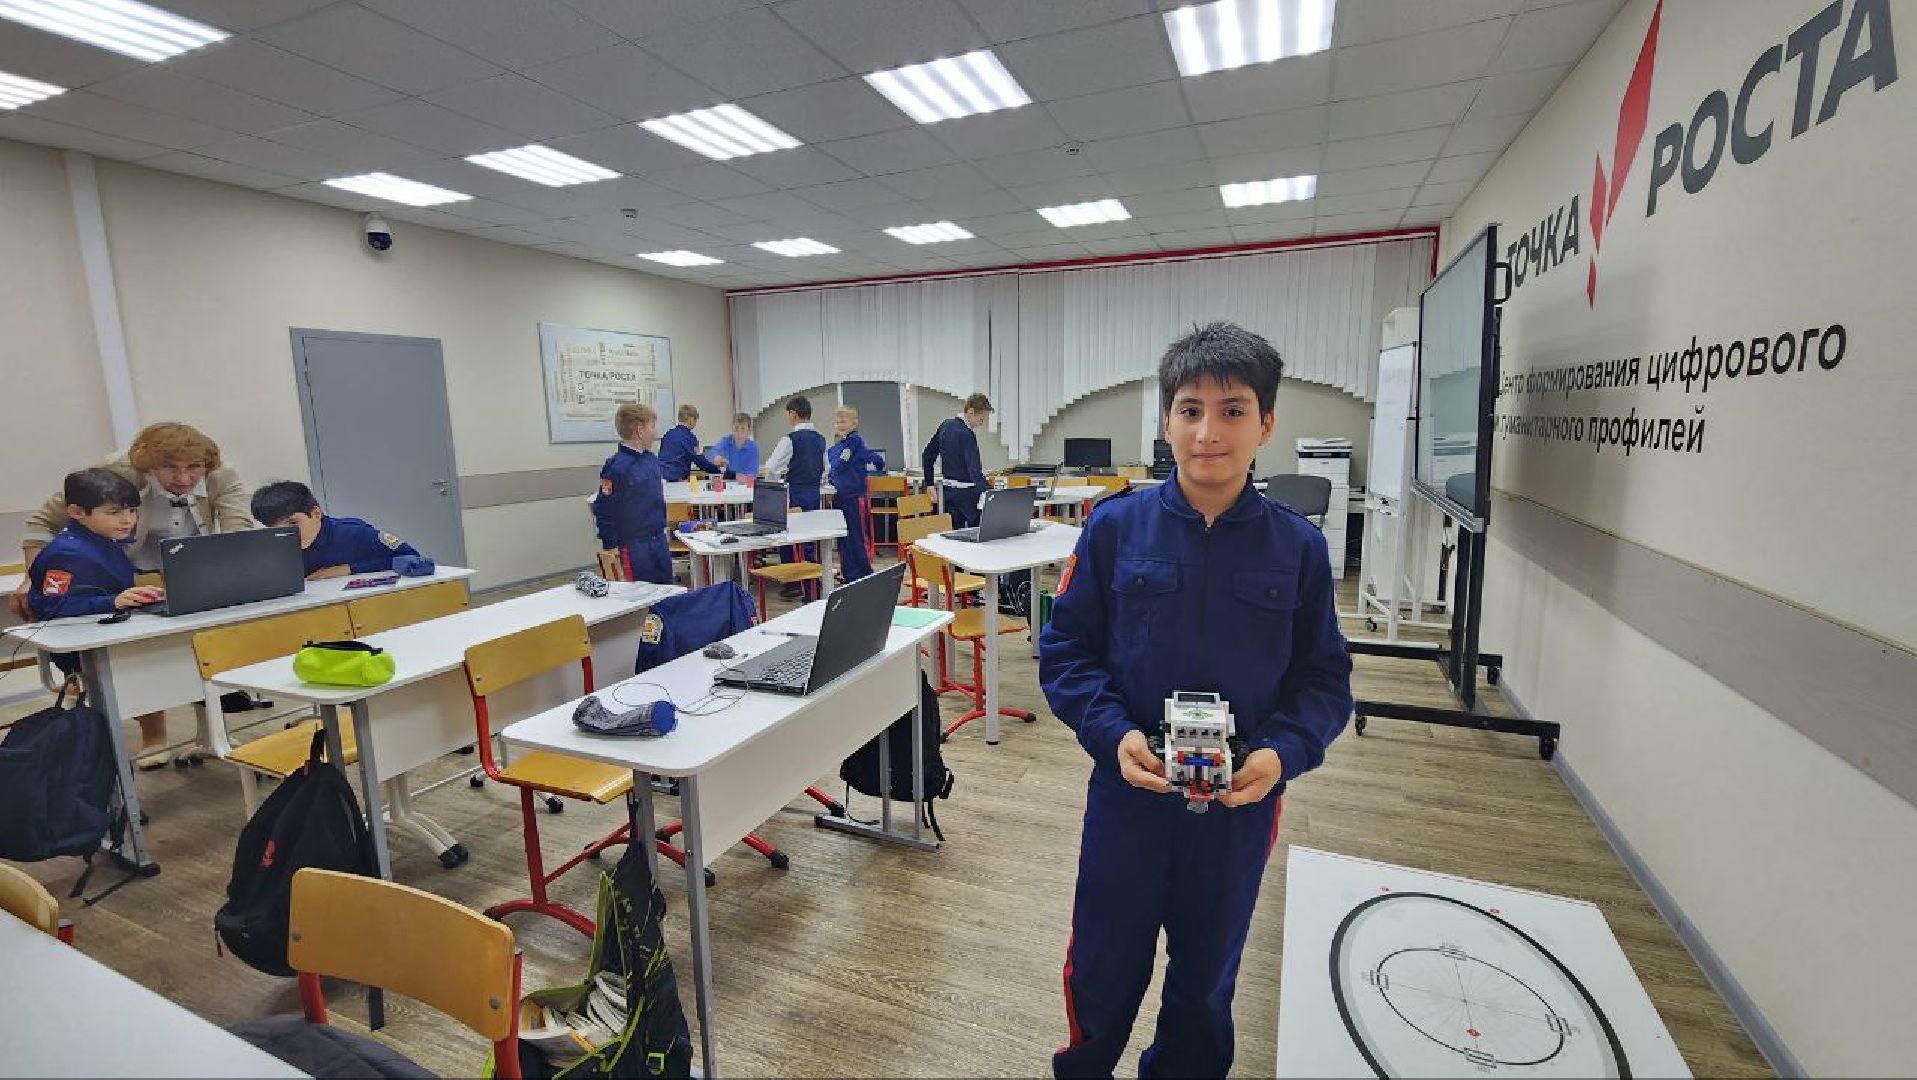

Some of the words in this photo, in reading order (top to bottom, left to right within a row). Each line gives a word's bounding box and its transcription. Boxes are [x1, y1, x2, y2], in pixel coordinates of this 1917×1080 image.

[1646, 0, 1898, 217] РОСТА
[1526, 357, 1641, 401] формирования
[1647, 323, 1847, 393] цифрового
[1502, 415, 1584, 446] гуманитарного
[1588, 404, 1706, 456] профилей
